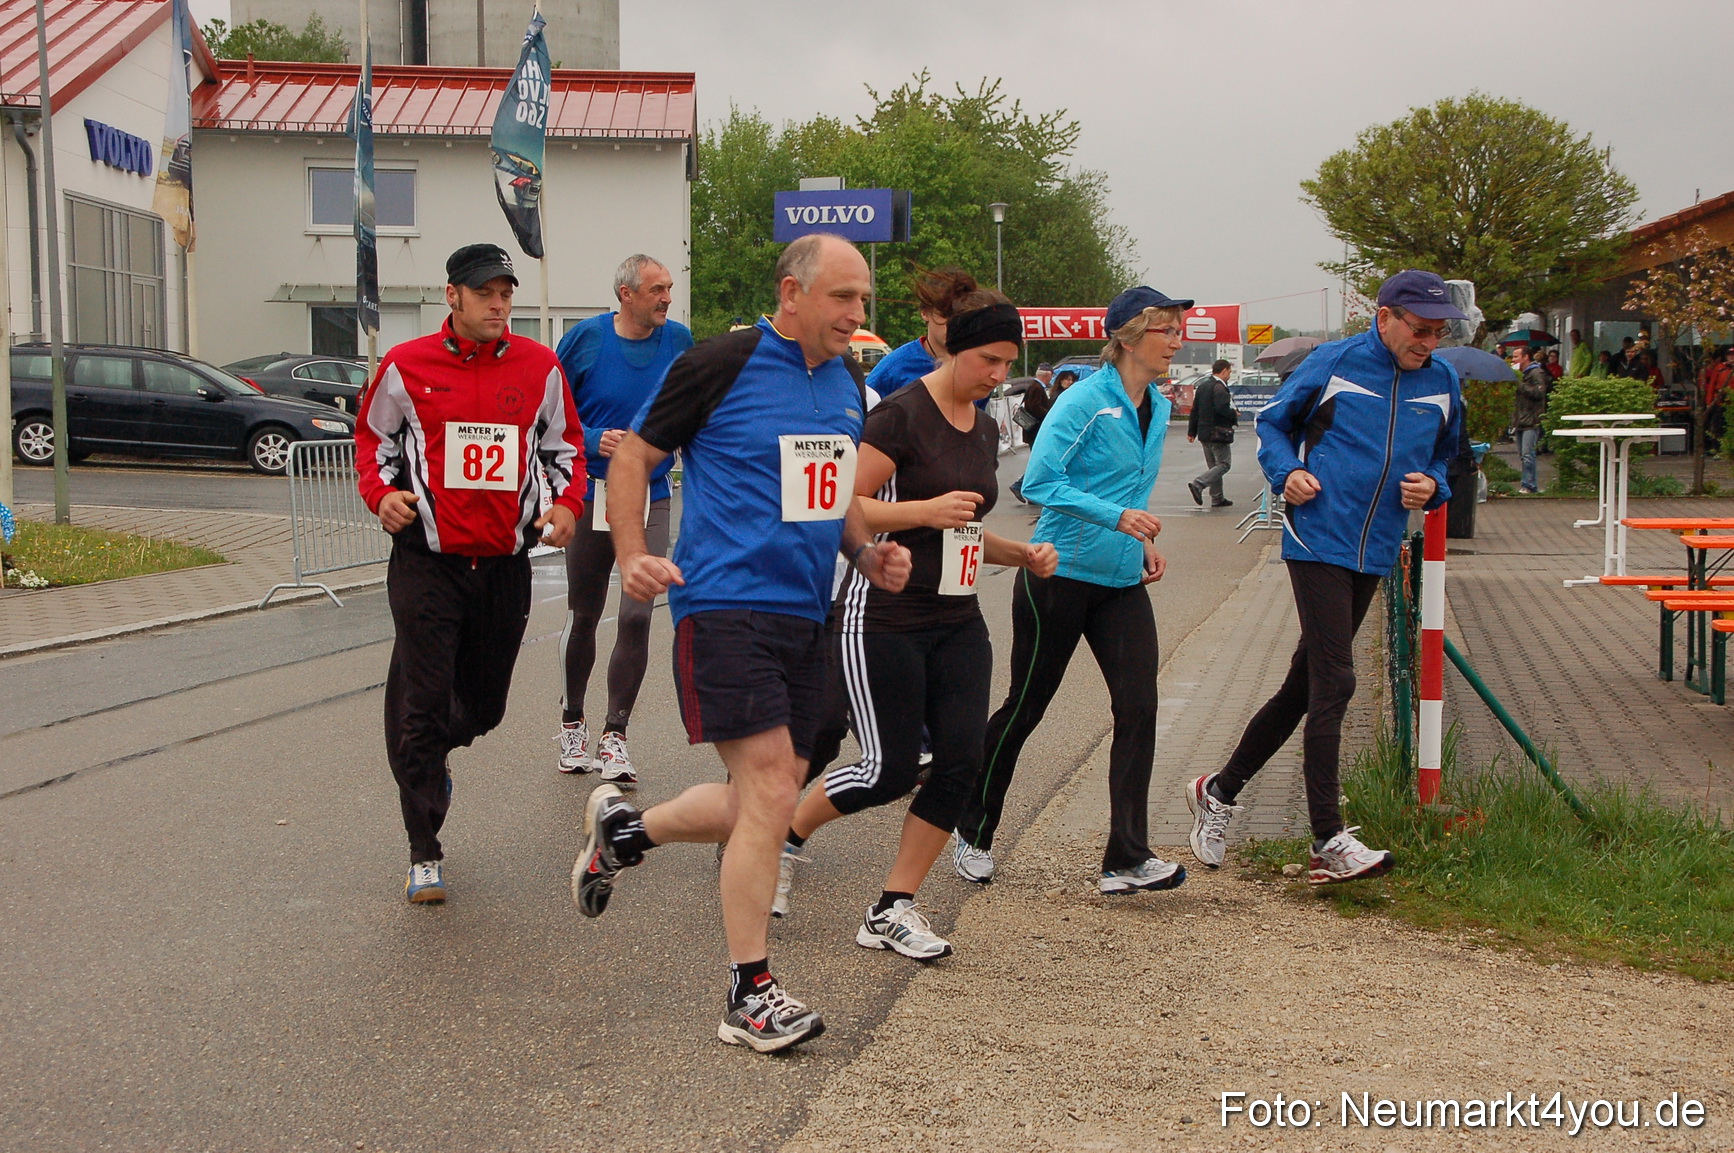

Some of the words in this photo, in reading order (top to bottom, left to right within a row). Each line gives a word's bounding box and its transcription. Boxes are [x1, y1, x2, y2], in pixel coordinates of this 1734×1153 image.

[84, 118, 153, 176] VOLVO
[785, 205, 875, 224] VOLVO
[458, 426, 491, 434] MEYER
[795, 441, 831, 450] MEYER
[795, 450, 832, 459] WERBUNG
[463, 443, 505, 482] 82
[804, 461, 837, 510] 16
[953, 526, 978, 534] MEYER
[960, 545, 979, 587] 15
